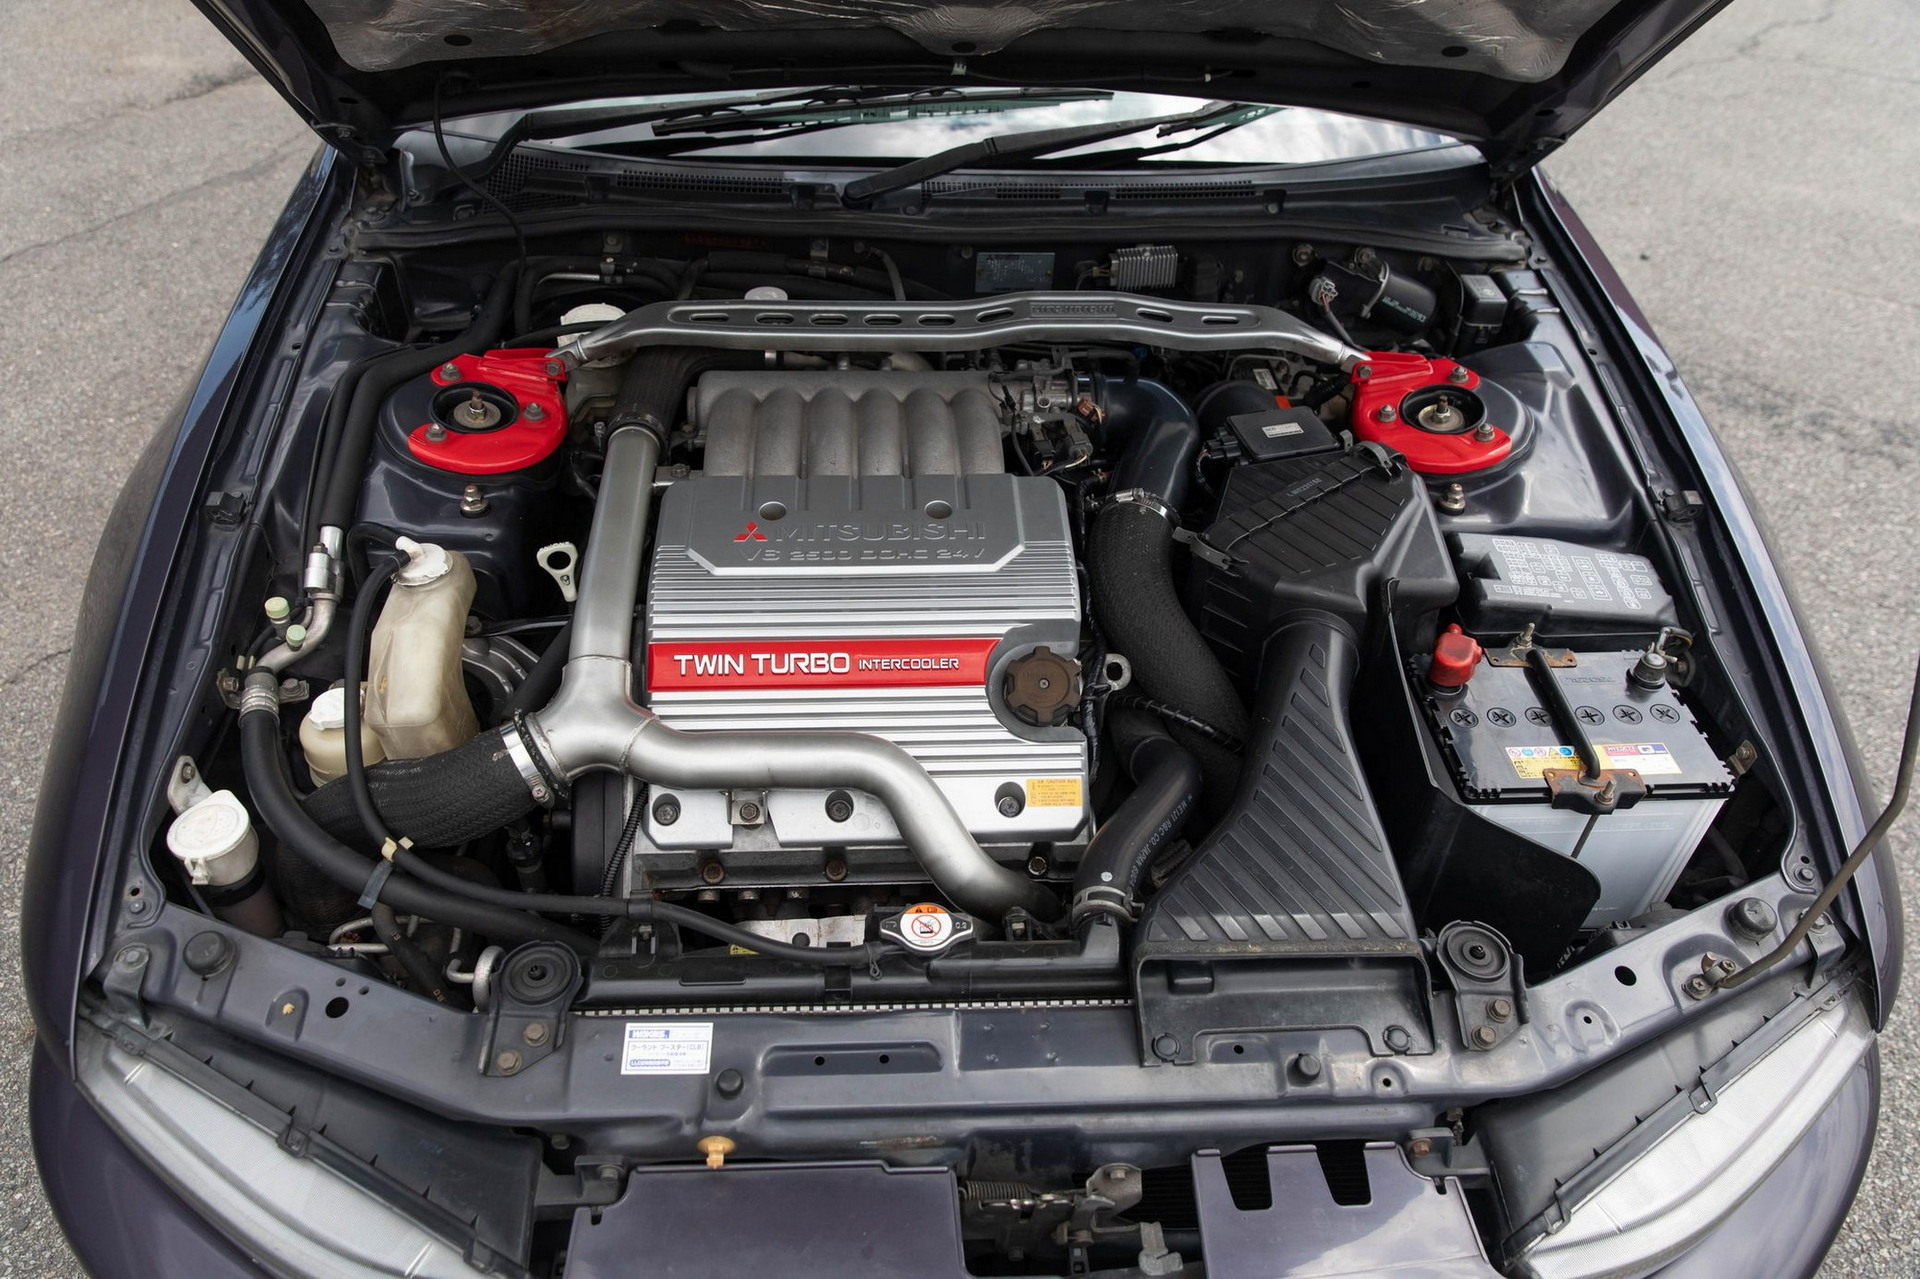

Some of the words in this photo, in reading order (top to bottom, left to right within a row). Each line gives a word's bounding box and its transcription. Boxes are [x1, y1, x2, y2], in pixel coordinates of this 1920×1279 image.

[775, 522, 986, 542] MITSUBISHI
[740, 548, 781, 561] V6
[790, 549, 853, 561] 2500
[860, 549, 928, 560] DOHC
[936, 547, 985, 559] 24V
[673, 653, 745, 676] TWIN
[751, 652, 851, 675] TURBO
[858, 657, 960, 671] INTERCOOLER
